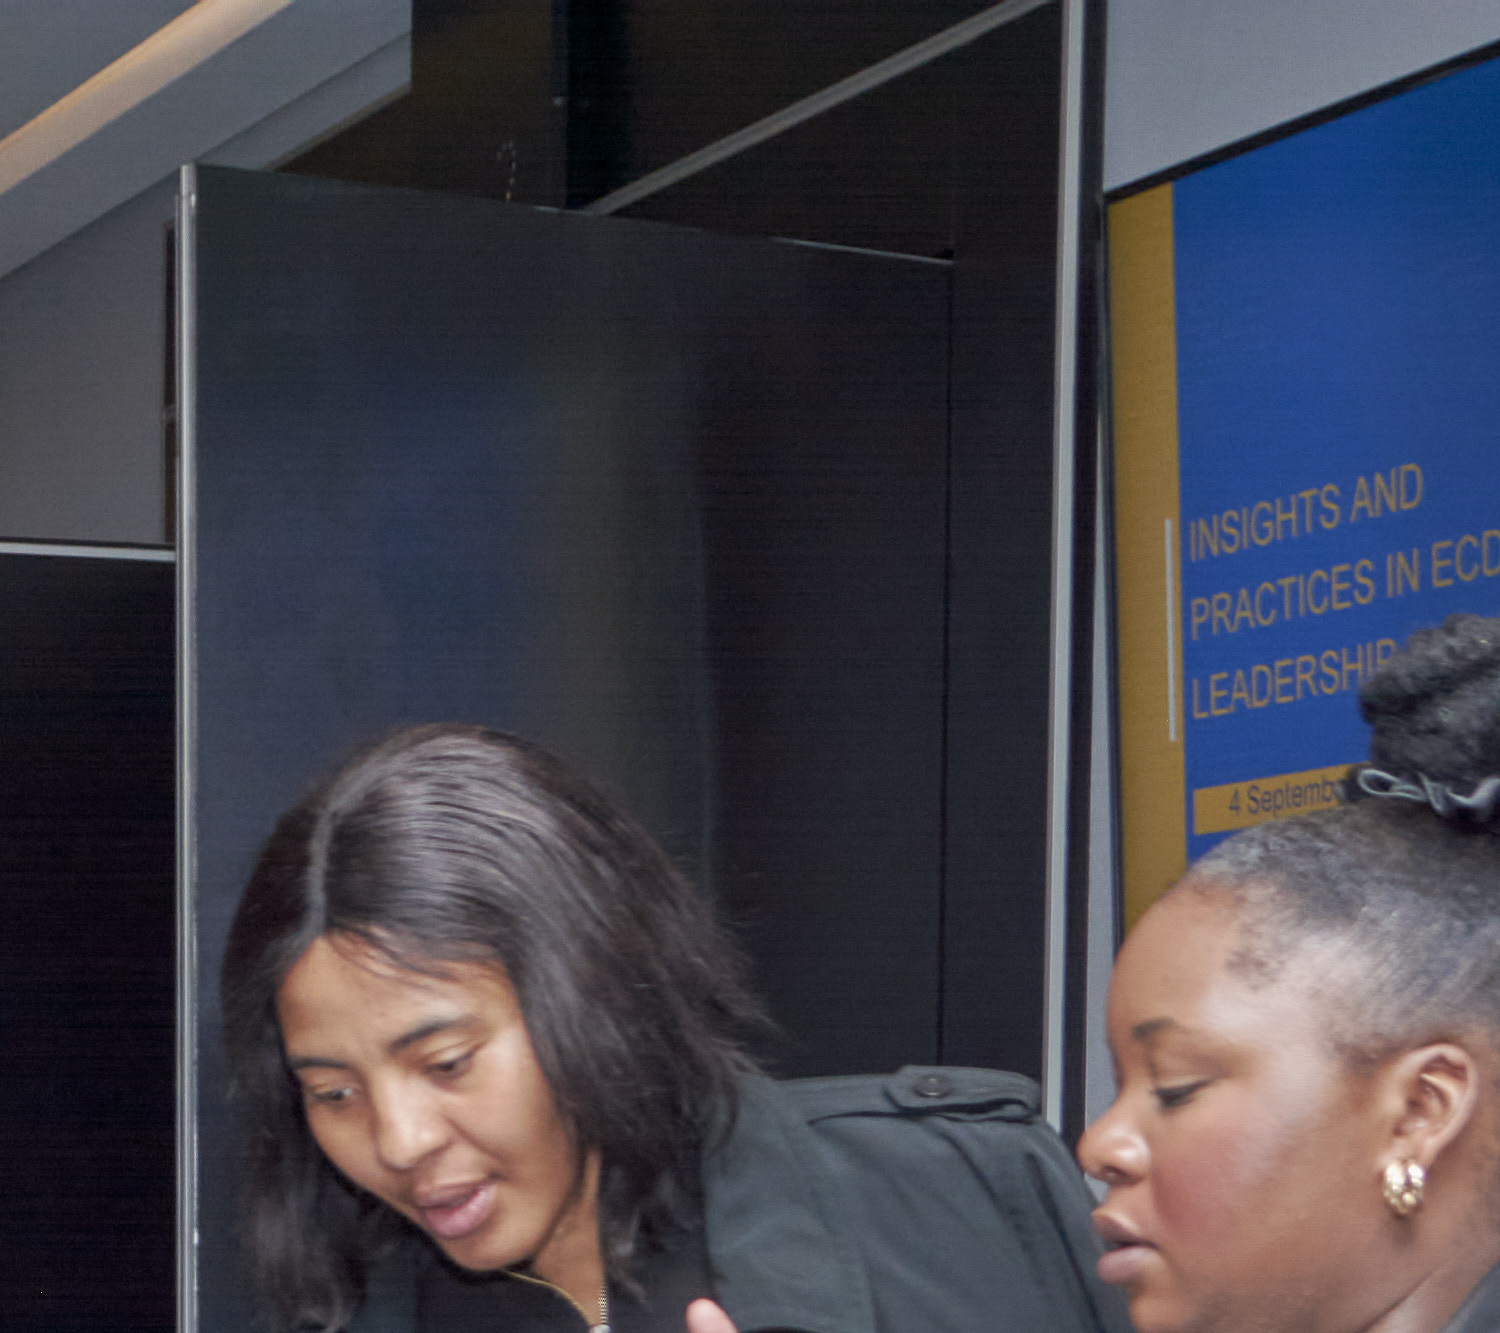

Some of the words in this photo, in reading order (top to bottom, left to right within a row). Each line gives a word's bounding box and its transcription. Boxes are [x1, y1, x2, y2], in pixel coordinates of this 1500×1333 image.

[1189, 483, 1342, 563] INSIGHTS
[1349, 462, 1424, 523] AND
[1190, 558, 1376, 641] PRACTICES
[1386, 547, 1421, 599] IN
